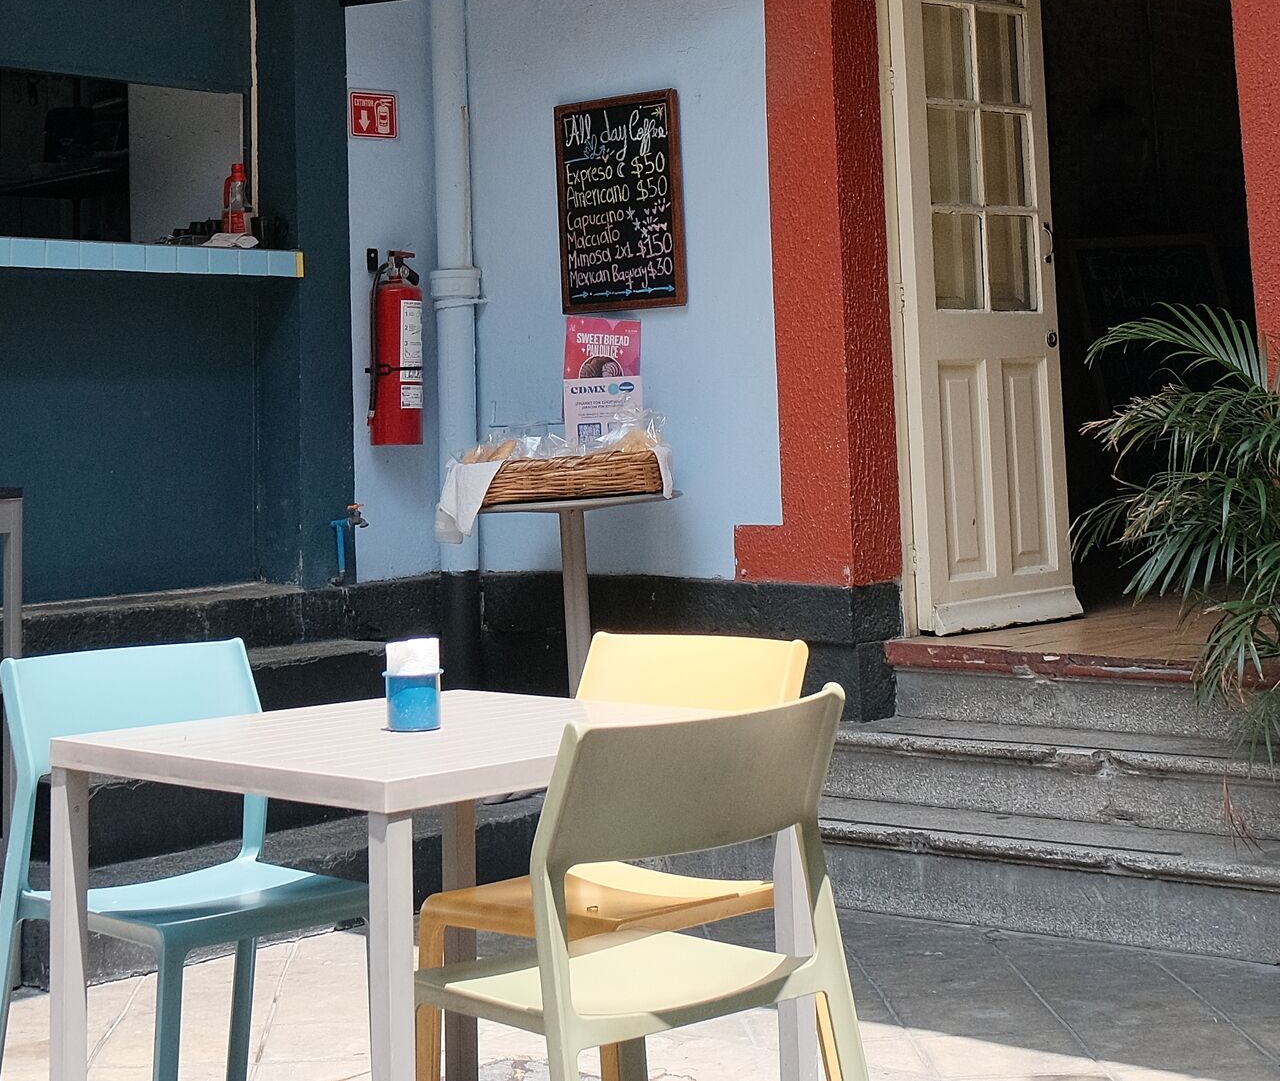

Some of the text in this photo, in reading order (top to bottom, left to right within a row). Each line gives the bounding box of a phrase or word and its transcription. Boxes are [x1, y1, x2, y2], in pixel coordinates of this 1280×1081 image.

[566, 109, 667, 161] All day Coffee
[566, 151, 666, 191] Expreso $50
[567, 175, 668, 209] Americano $50
[567, 209, 625, 236] Capuccino
[567, 224, 620, 250] Macciato
[568, 232, 673, 270] Mimosa 2x1 $150
[570, 269, 611, 289] Mexican
[647, 257, 673, 279] $30
[576, 332, 630, 347] SWEET BREAD
[570, 385, 606, 395] CDMX
